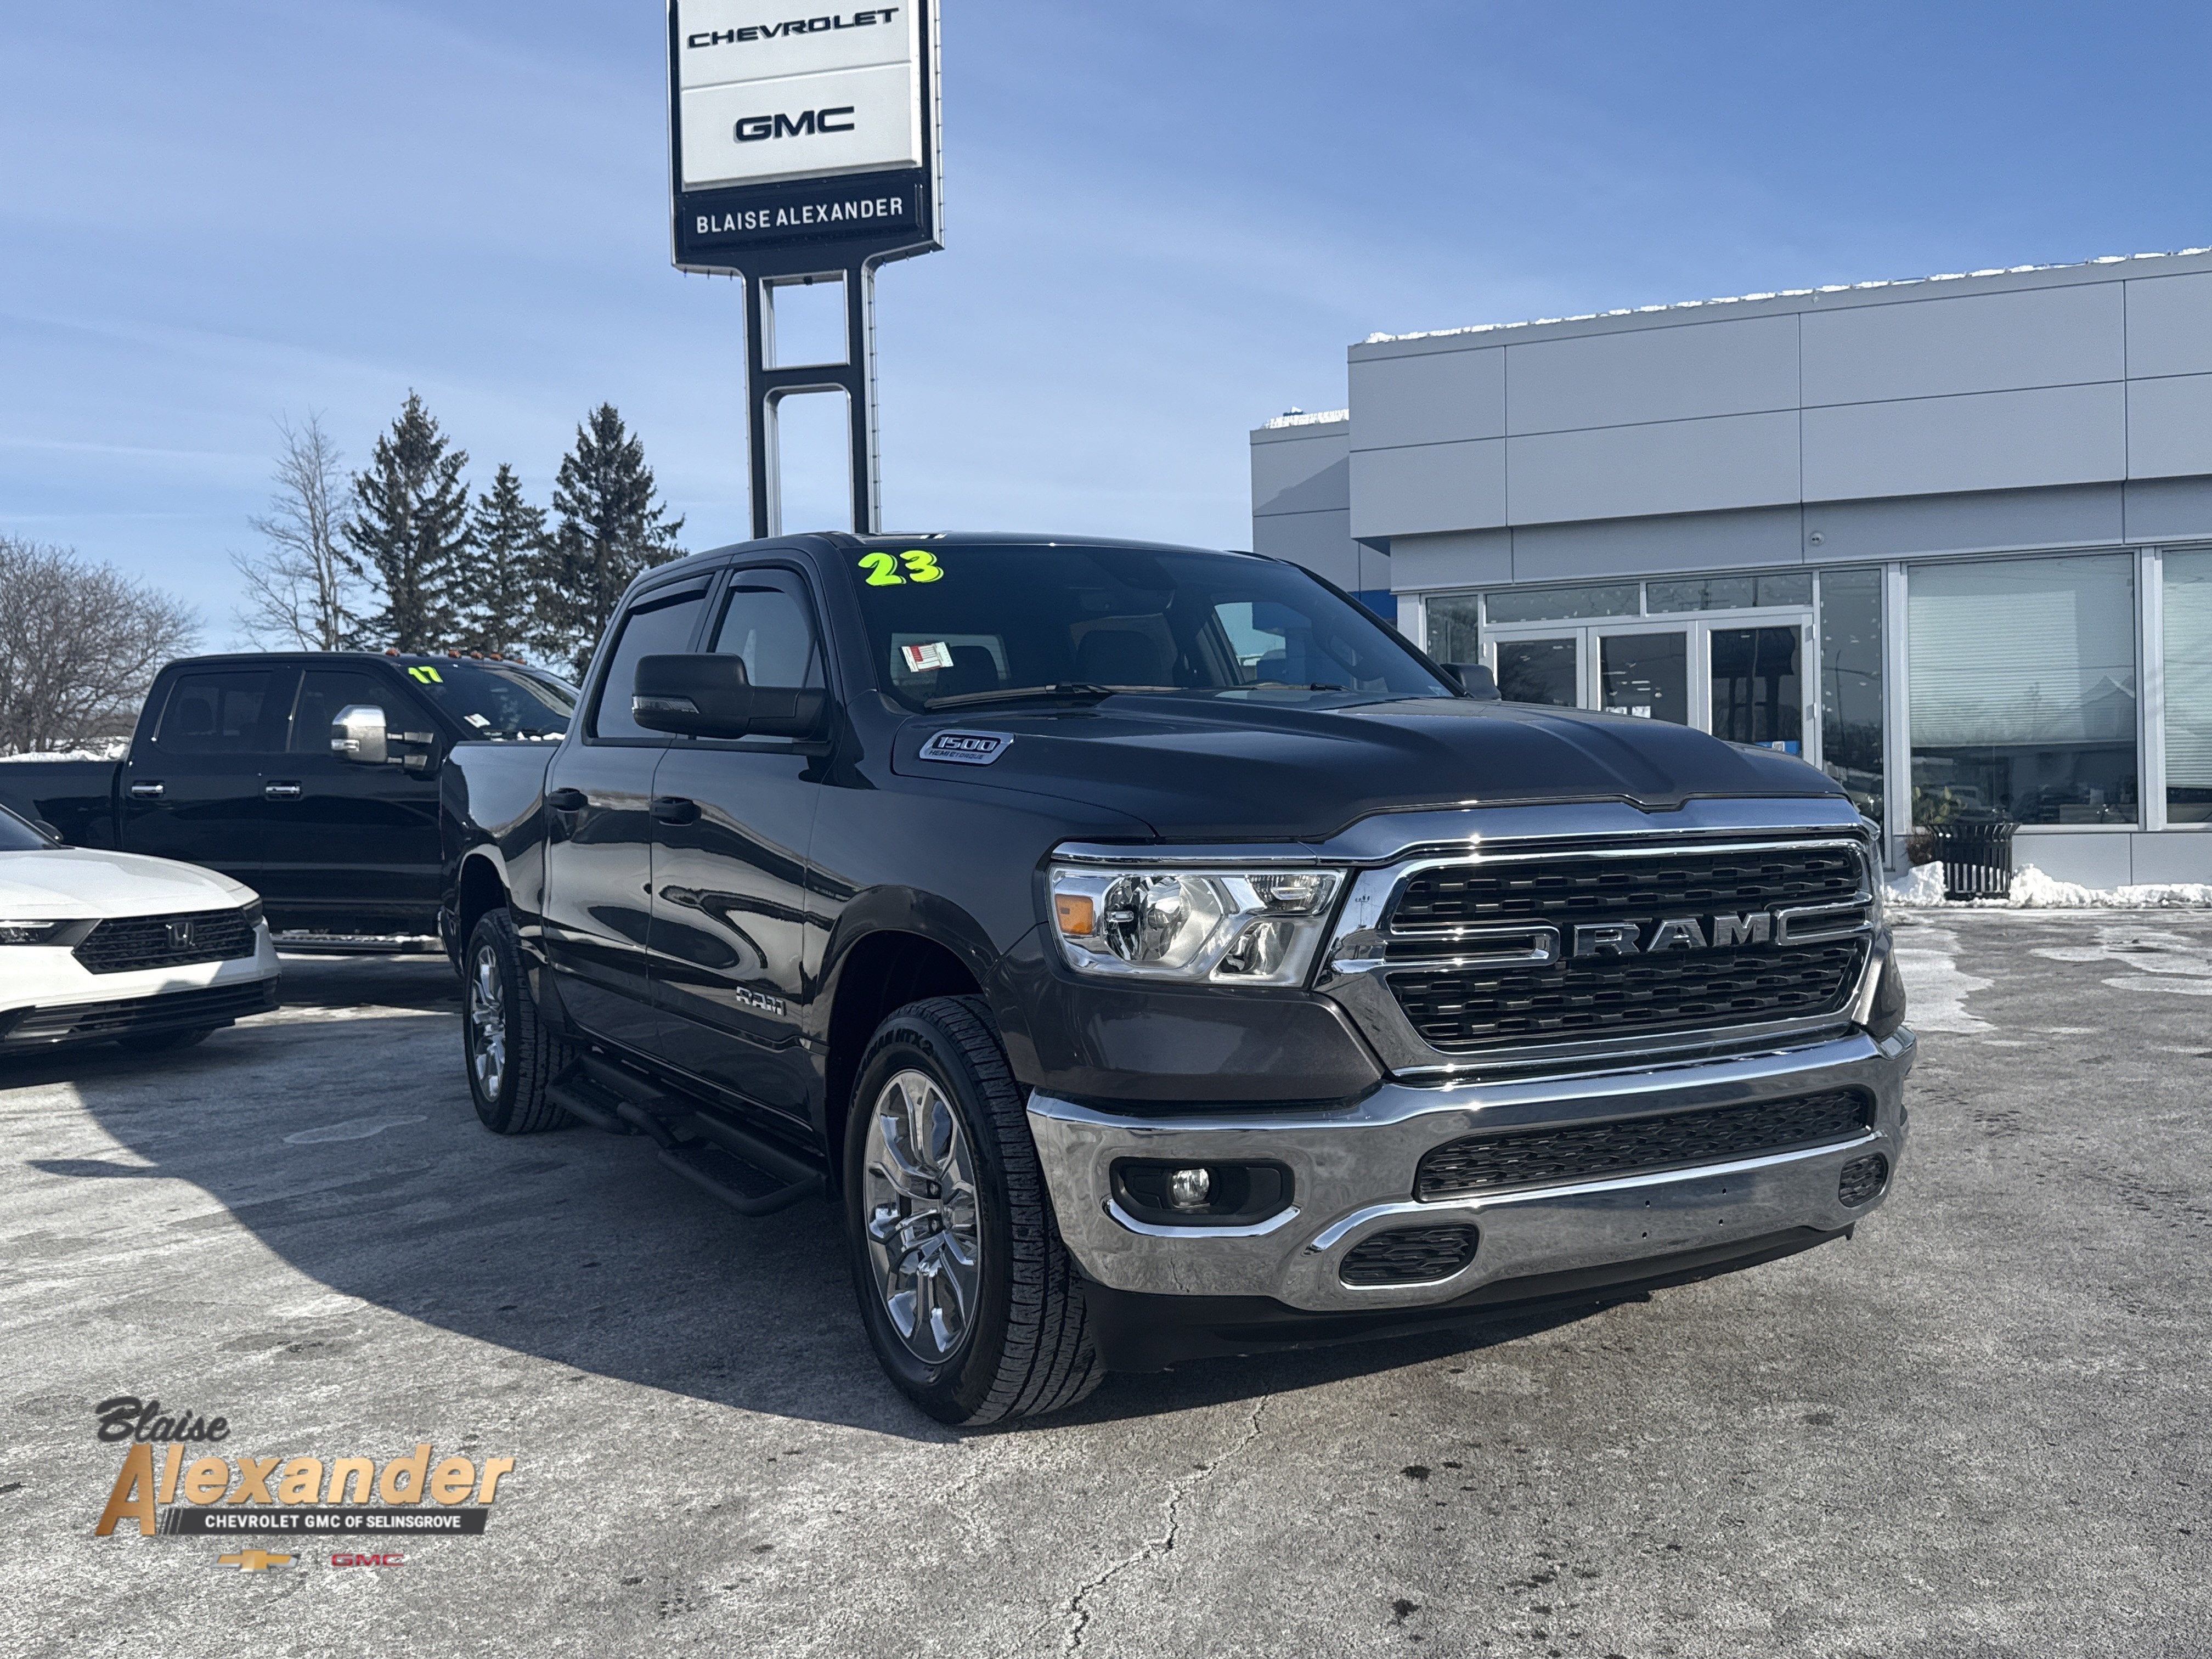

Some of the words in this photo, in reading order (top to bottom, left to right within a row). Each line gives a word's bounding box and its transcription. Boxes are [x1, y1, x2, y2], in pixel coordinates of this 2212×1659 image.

[689, 8, 899, 48] CHEVROLET
[735, 106, 855, 142] GMC
[697, 210, 770, 234] BLAISE
[776, 197, 903, 228] ALEXANDER
[858, 550, 944, 586] 23
[408, 665, 443, 684] 17
[938, 737, 998, 752] 1500
[1574, 912, 1770, 957] RAM
[736, 986, 786, 1015] RAM
